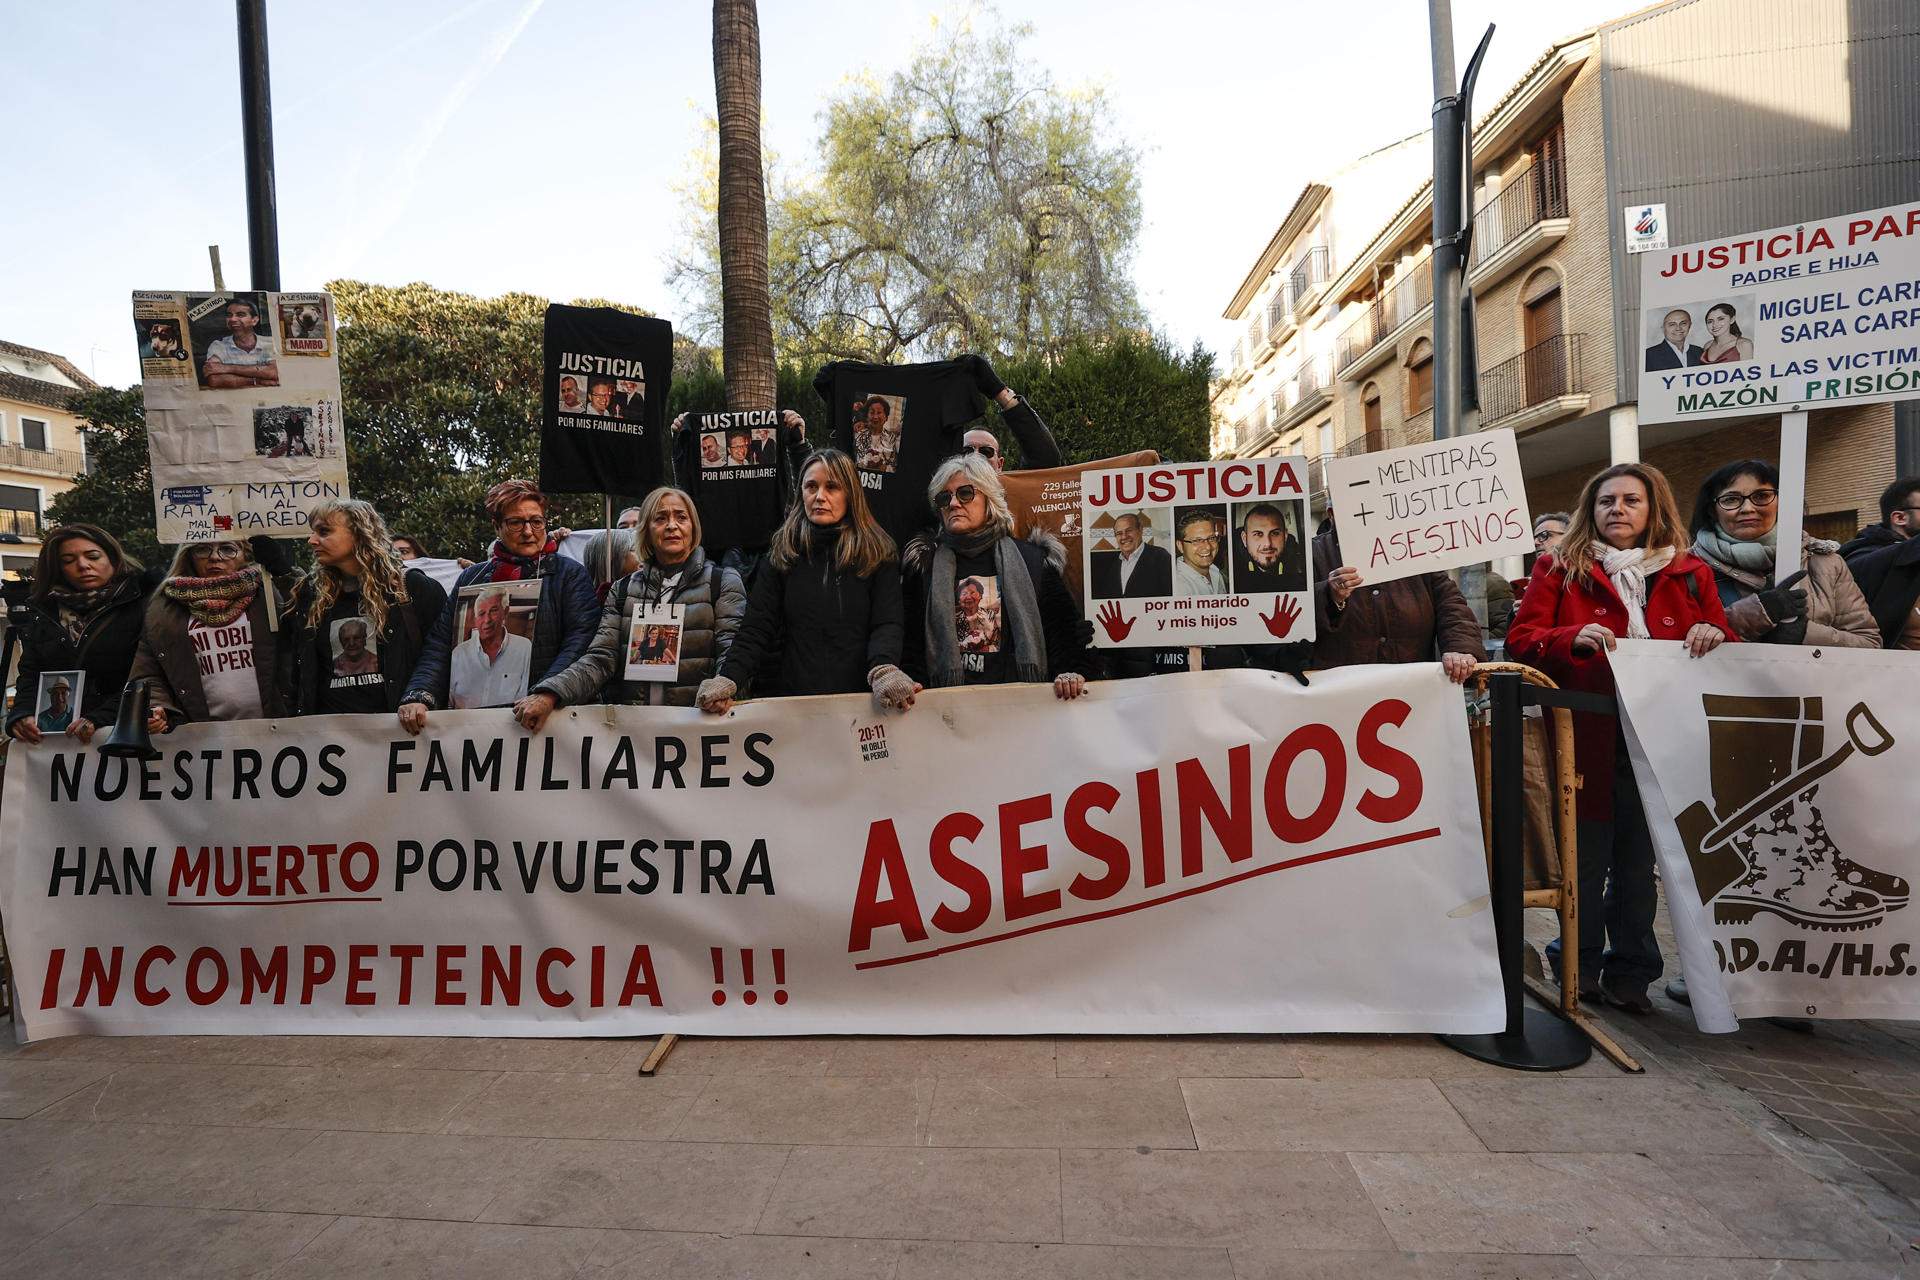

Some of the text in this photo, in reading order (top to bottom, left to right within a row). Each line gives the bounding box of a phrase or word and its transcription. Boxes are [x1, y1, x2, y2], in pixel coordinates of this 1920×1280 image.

[1731, 251, 1879, 287] PADRE E HIJA
[1760, 292, 1850, 321] MIGUEL
[1781, 318, 1847, 344] SARA
[290, 339, 323, 350] MAMBO
[559, 352, 645, 380] JUSTICIA
[1662, 346, 1920, 390] Y TODAS LAS VICTIM
[1677, 384, 1778, 412] MAZÓN
[558, 416, 644, 436] POR MIS FAMILIARES
[701, 411, 778, 431] JUSTICIA
[1377, 441, 1498, 486] MENTIRAS
[702, 471, 718, 481] POR
[719, 470, 734, 480] MIS
[1088, 462, 1303, 507] JUSTICIA
[1041, 491, 1048, 500] 0
[1044, 482, 1060, 491] 229
[274, 499, 297, 510] AL
[1383, 475, 1509, 521] JUSTICIA
[164, 503, 219, 518] RATA
[1031, 503, 1071, 514] VALENCIA
[189, 520, 211, 529] MAL
[237, 511, 308, 529] PARED
[1371, 508, 1524, 568] ASESINOS
[1144, 595, 1249, 613] por mi marido
[1157, 614, 1238, 631] y mis hijos
[189, 631, 211, 654] NI
[199, 654, 215, 676] NI
[960, 653, 985, 673] OSA
[1155, 653, 1162, 664] Y
[1163, 653, 1184, 665] MIS
[861, 744, 869, 753] NI
[863, 754, 870, 762] NI
[50, 733, 775, 803] NUESTROS FAMILIARES
[847, 698, 1424, 953] ASESINOS
[48, 839, 776, 897] HAN MUERTO POR VUESTRA
[39, 944, 664, 1010] INCOMPETENCIA
